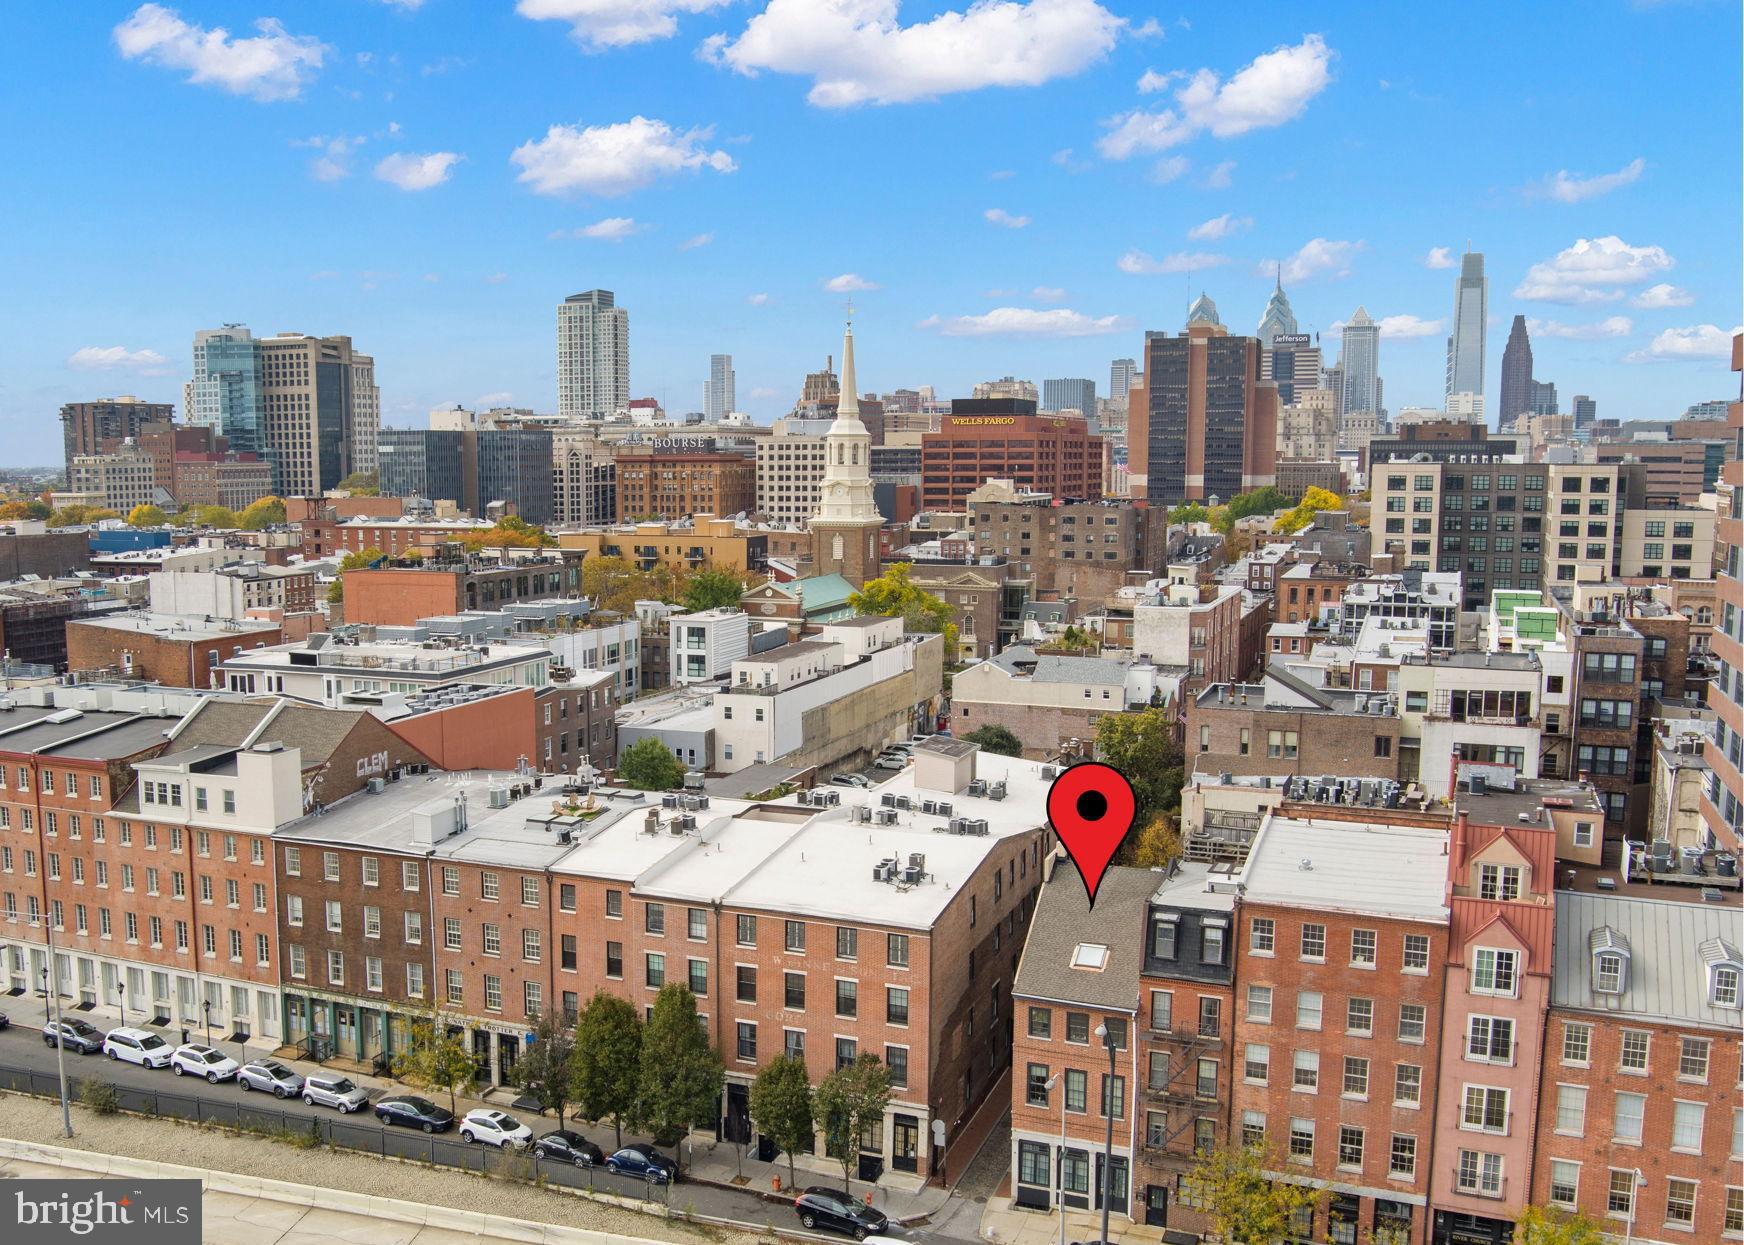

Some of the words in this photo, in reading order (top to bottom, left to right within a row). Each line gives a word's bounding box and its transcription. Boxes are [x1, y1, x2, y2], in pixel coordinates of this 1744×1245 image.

[951, 417, 983, 425] WELLS
[984, 417, 1015, 425] FARGO
[654, 437, 705, 448] BOURSE
[356, 750, 388, 777] CLEM
[484, 1025, 513, 1034] TROTTER
